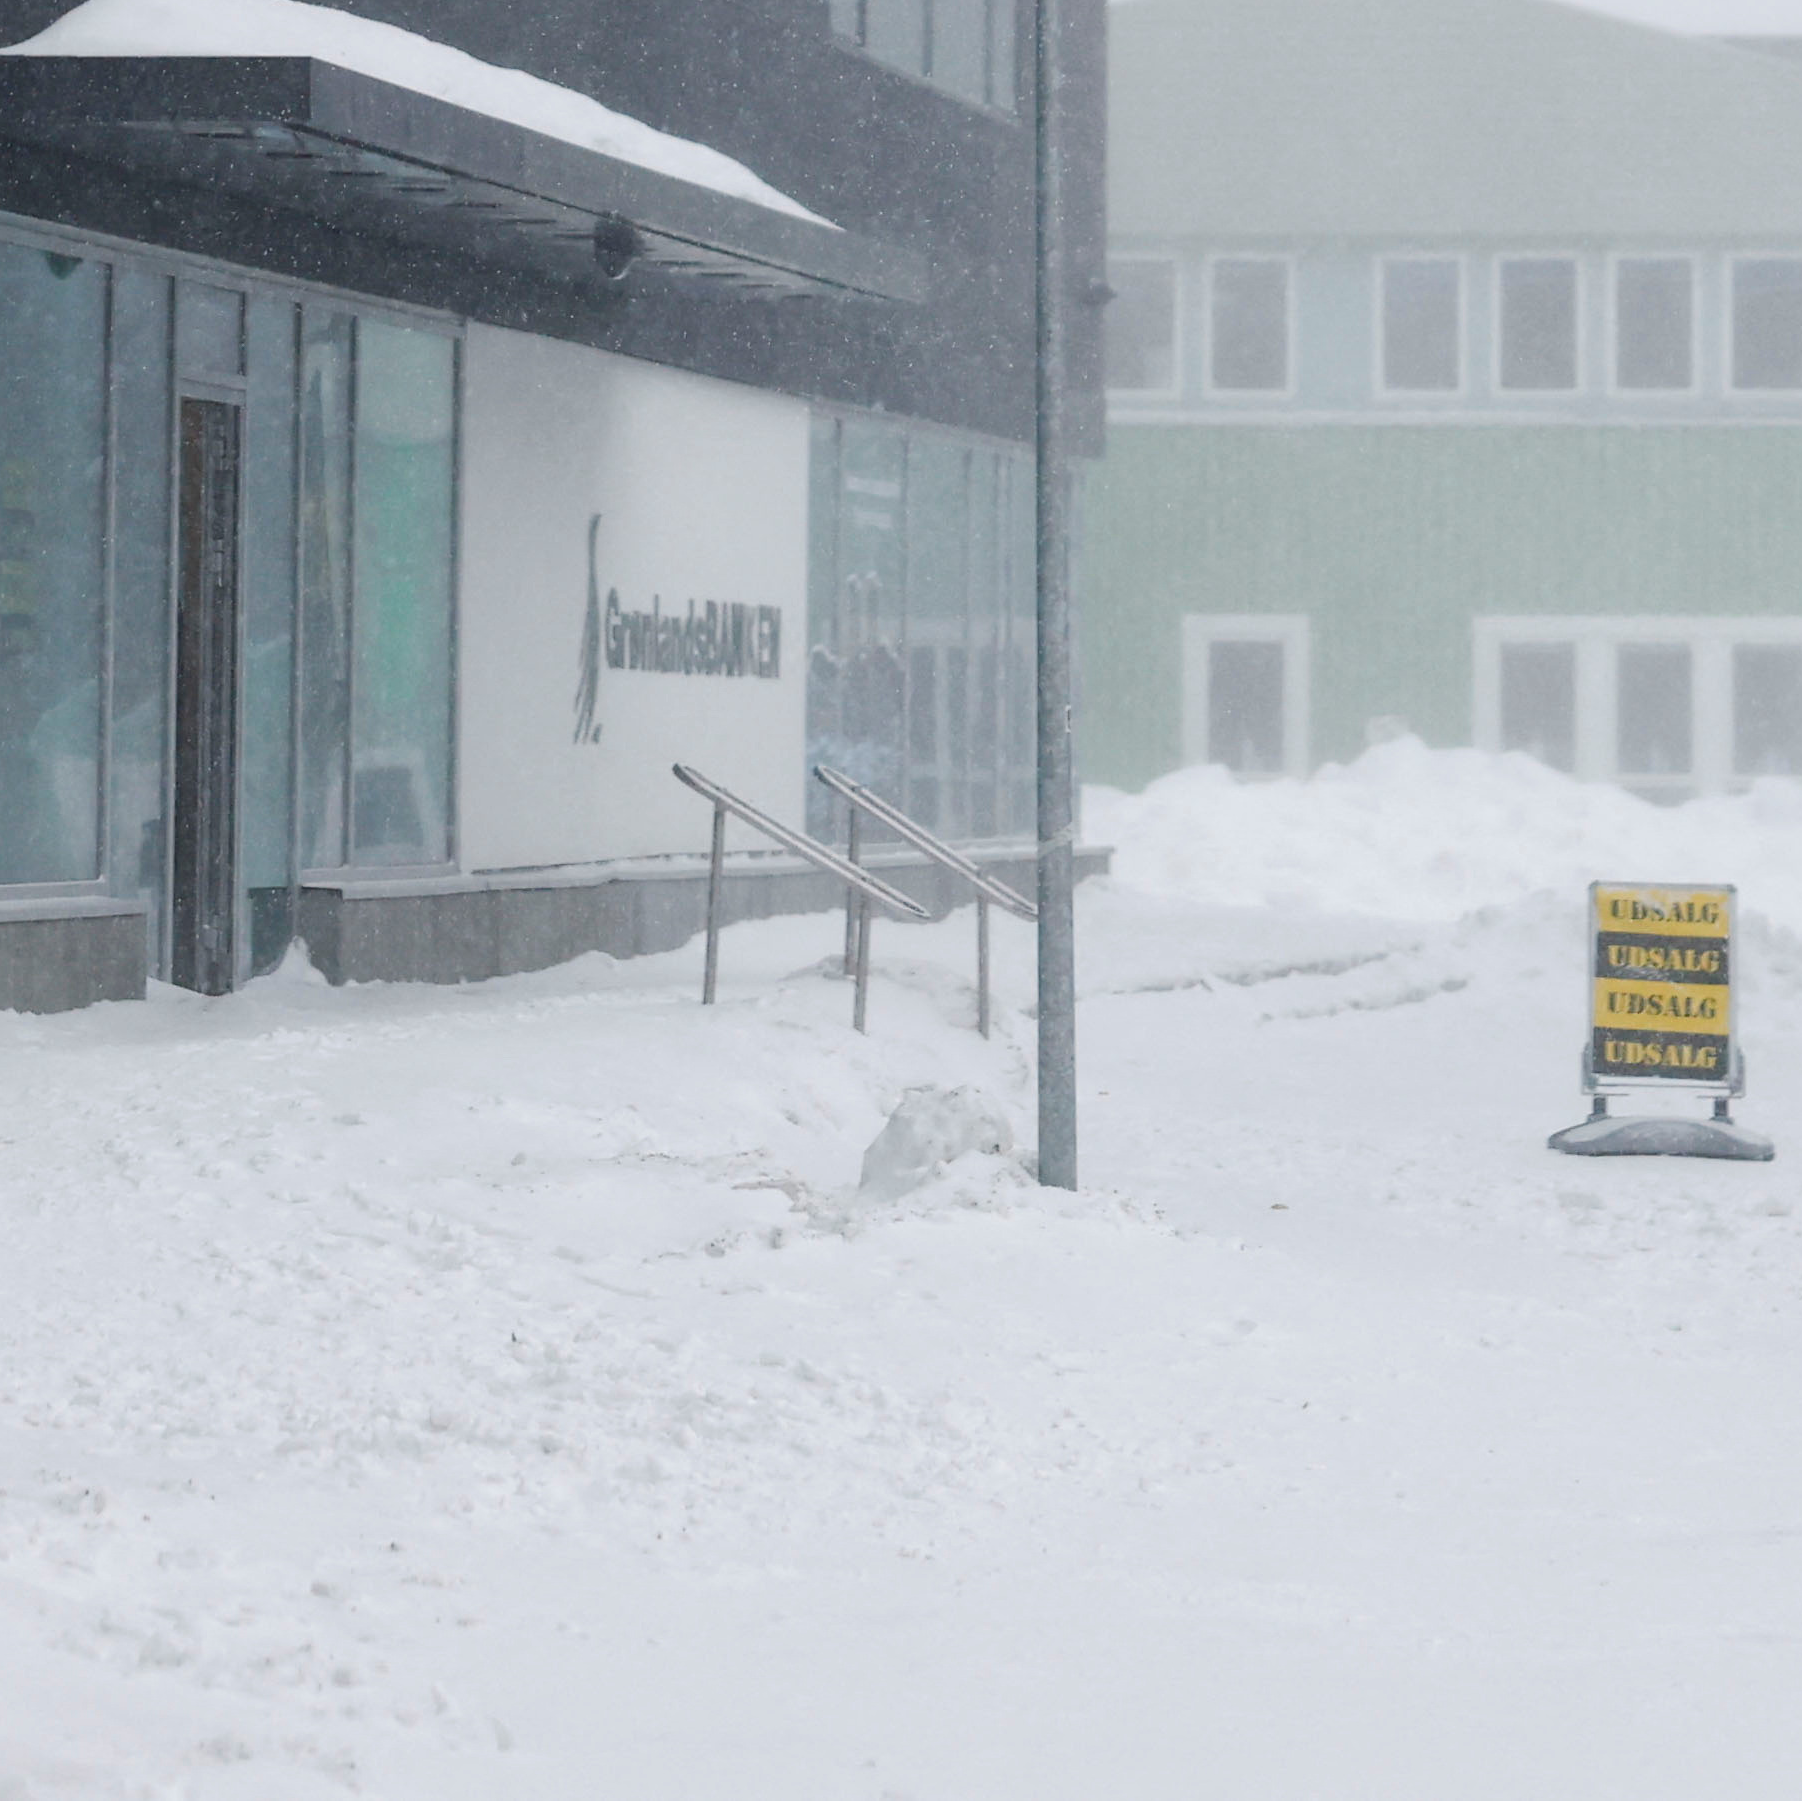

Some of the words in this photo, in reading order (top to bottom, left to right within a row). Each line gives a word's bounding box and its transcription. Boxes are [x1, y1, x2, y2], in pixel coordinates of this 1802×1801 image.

[1611, 898, 1719, 925] UDSALG
[1607, 944, 1720, 974] UDSALG
[1607, 991, 1717, 1020] UDSALG
[1604, 1040, 1718, 1070] UDSALG
